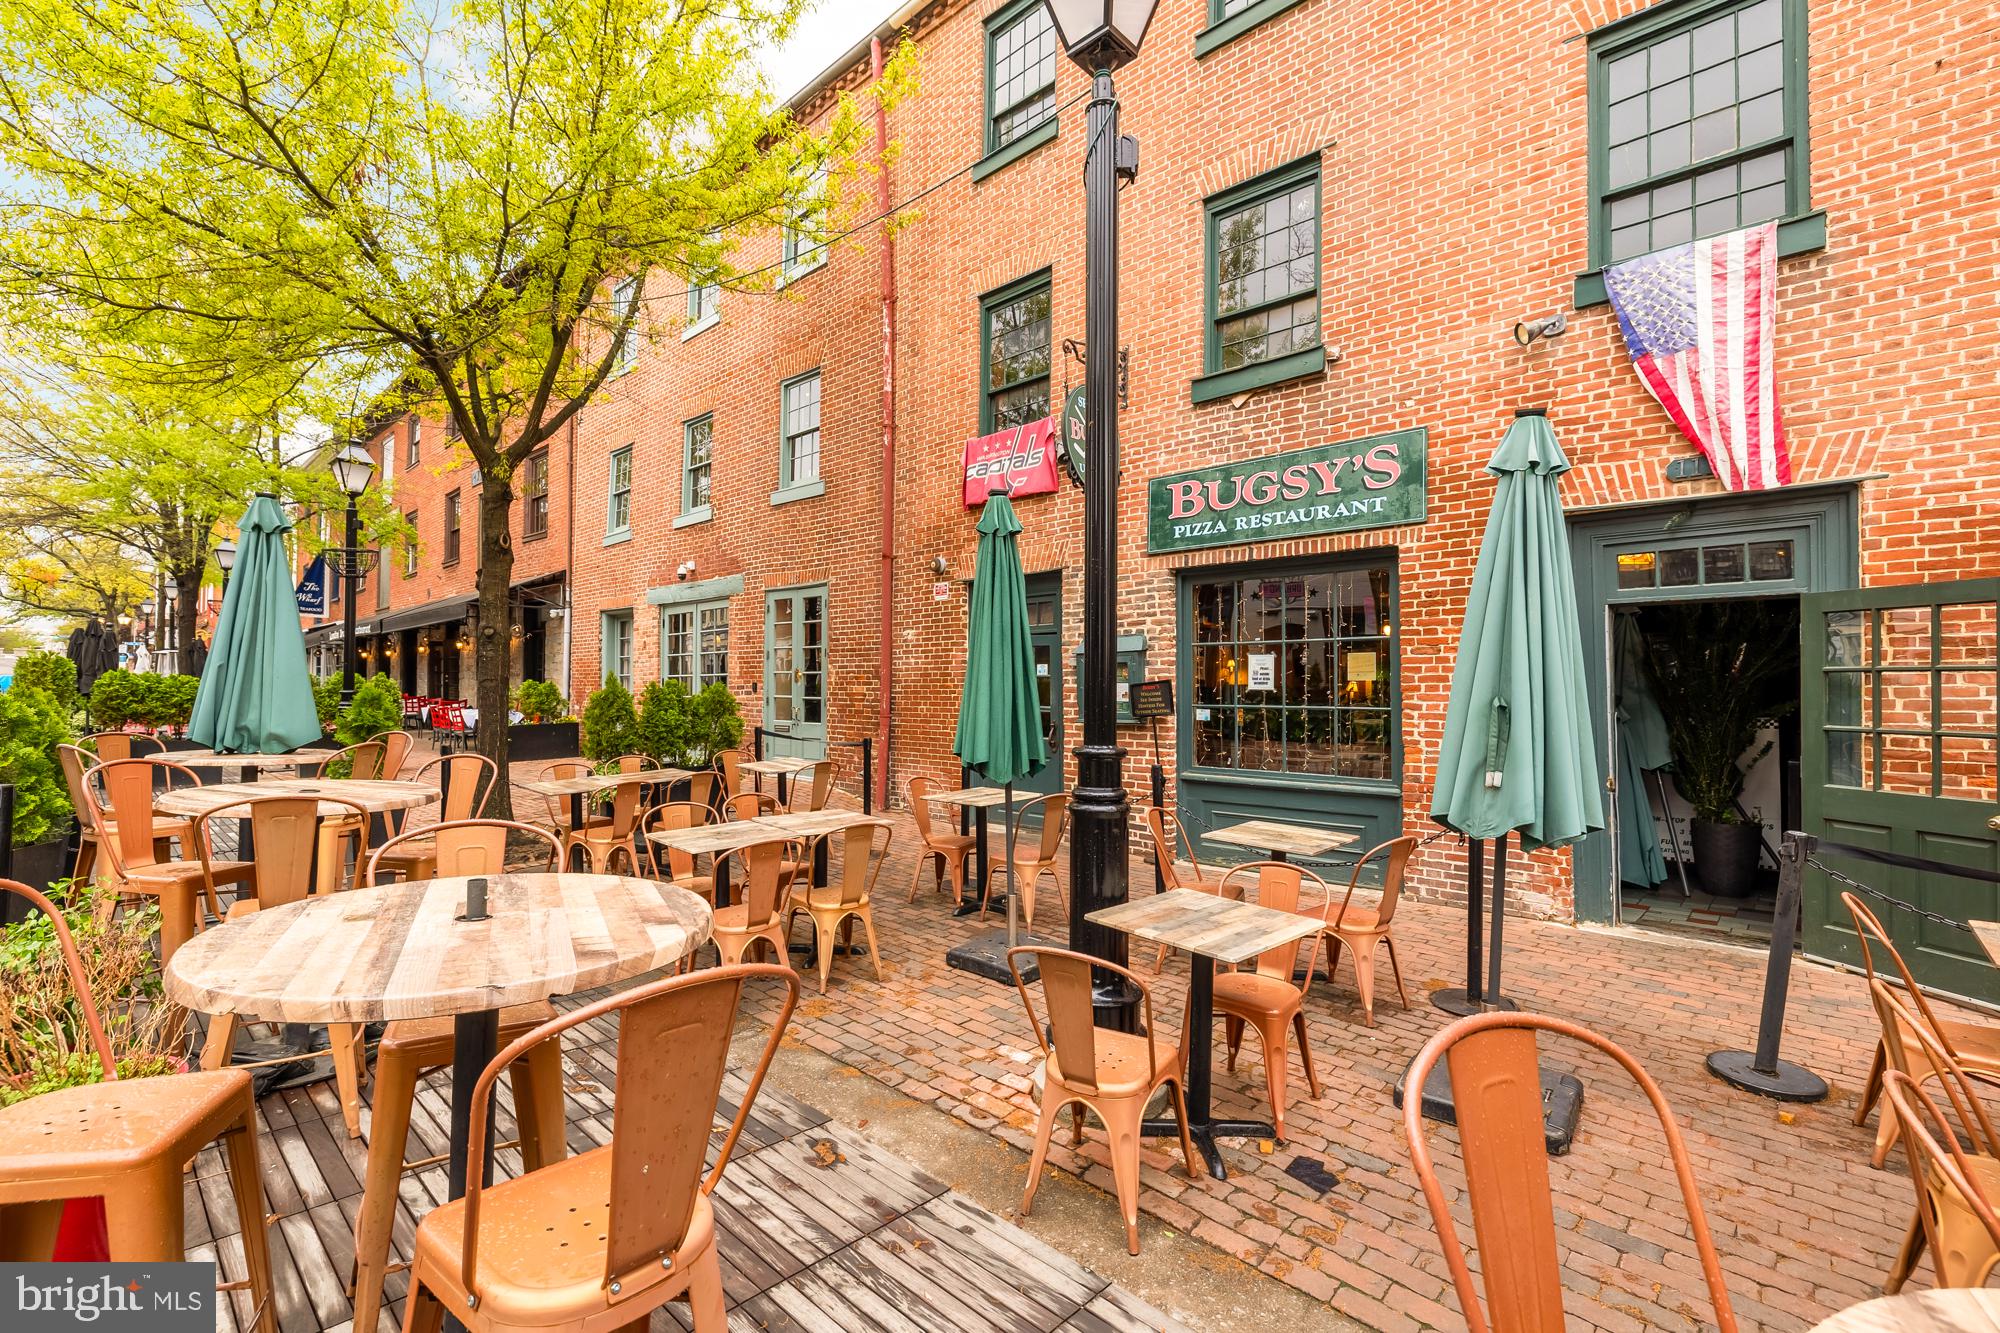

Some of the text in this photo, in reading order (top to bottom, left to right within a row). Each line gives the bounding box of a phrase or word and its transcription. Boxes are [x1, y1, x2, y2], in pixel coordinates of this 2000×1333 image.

[1167, 443, 1401, 520] BUGSY'S
[1173, 496, 1387, 538] PIZZA RESTAURANT
[295, 592, 324, 605] Wharf
[303, 582, 320, 591] The
